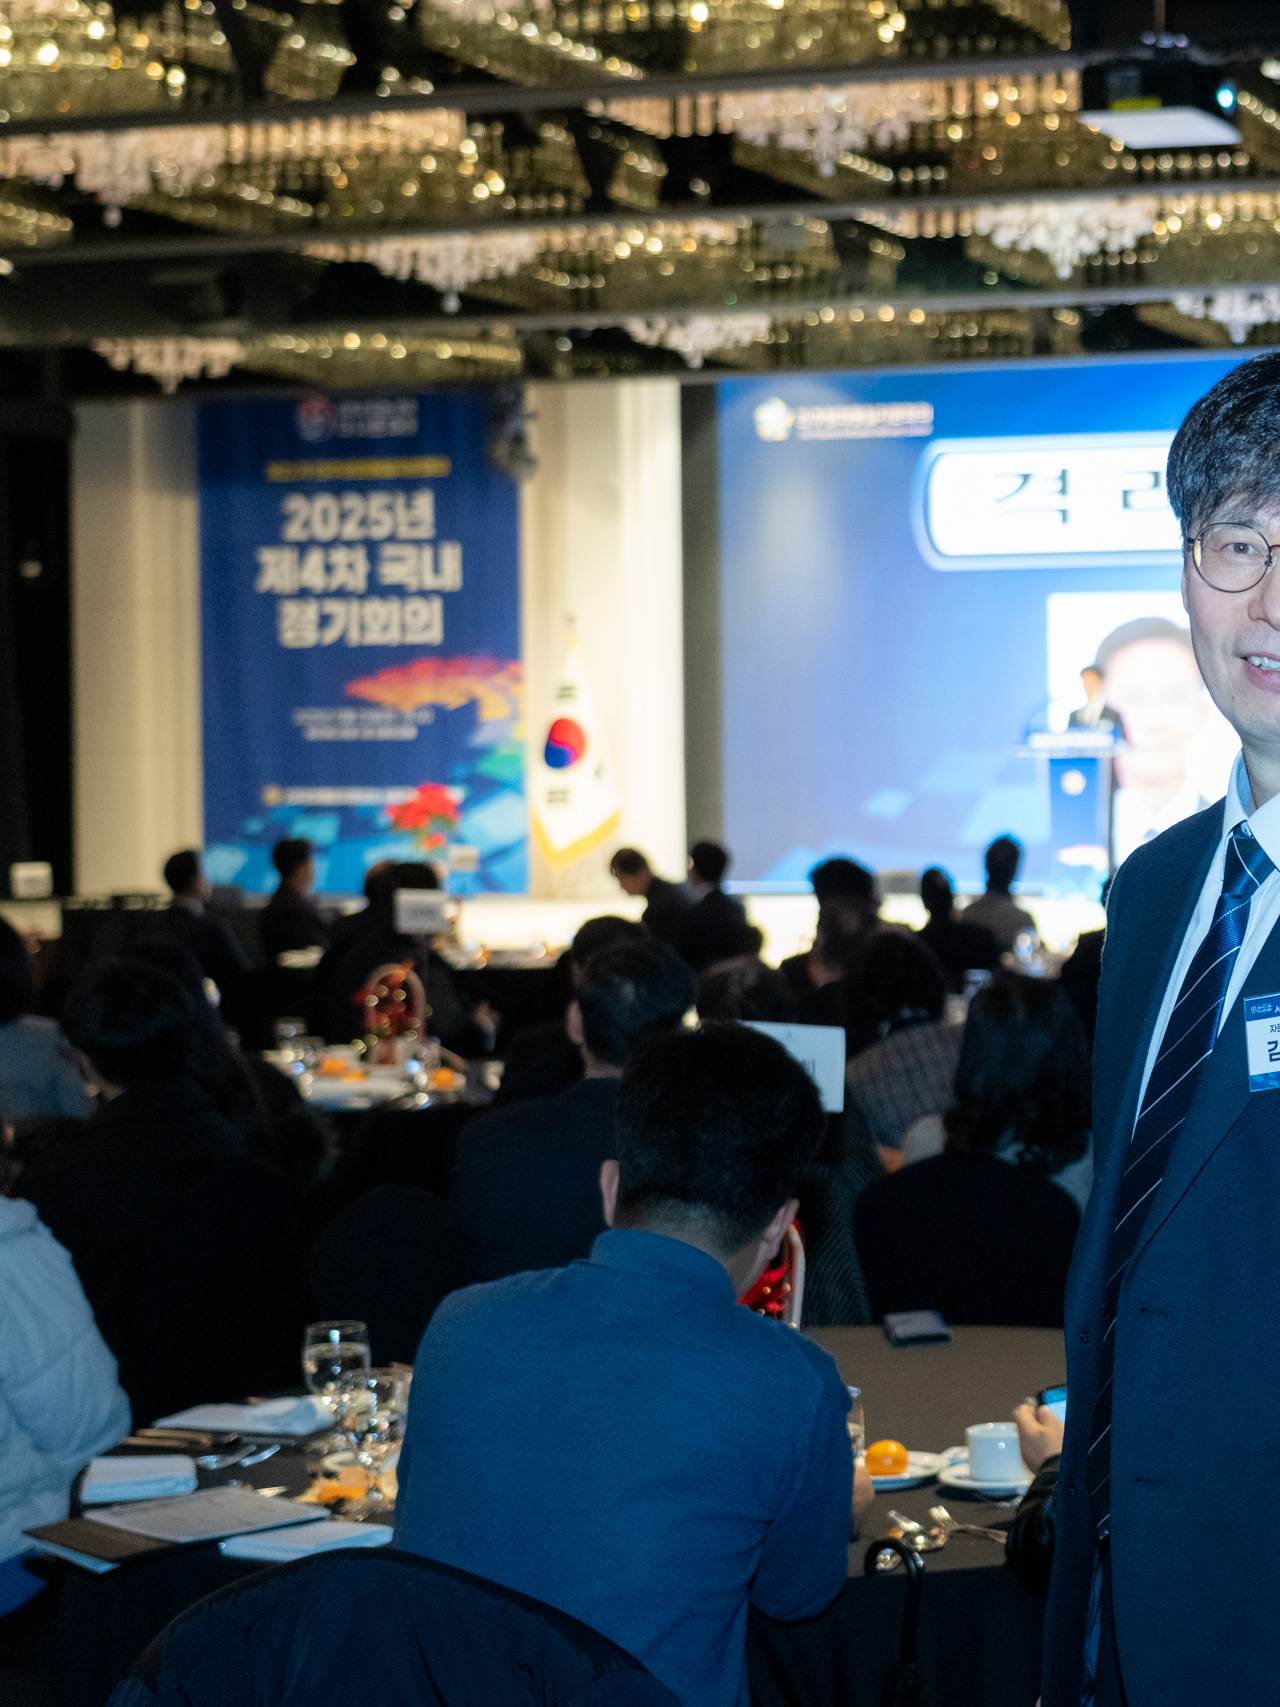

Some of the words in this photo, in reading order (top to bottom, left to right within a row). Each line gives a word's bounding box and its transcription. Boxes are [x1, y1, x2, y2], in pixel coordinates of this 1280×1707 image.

[283, 491, 435, 542] 2025년
[259, 548, 368, 594] 제4차
[380, 544, 462, 592] 국내
[279, 598, 443, 647] 정기회의
